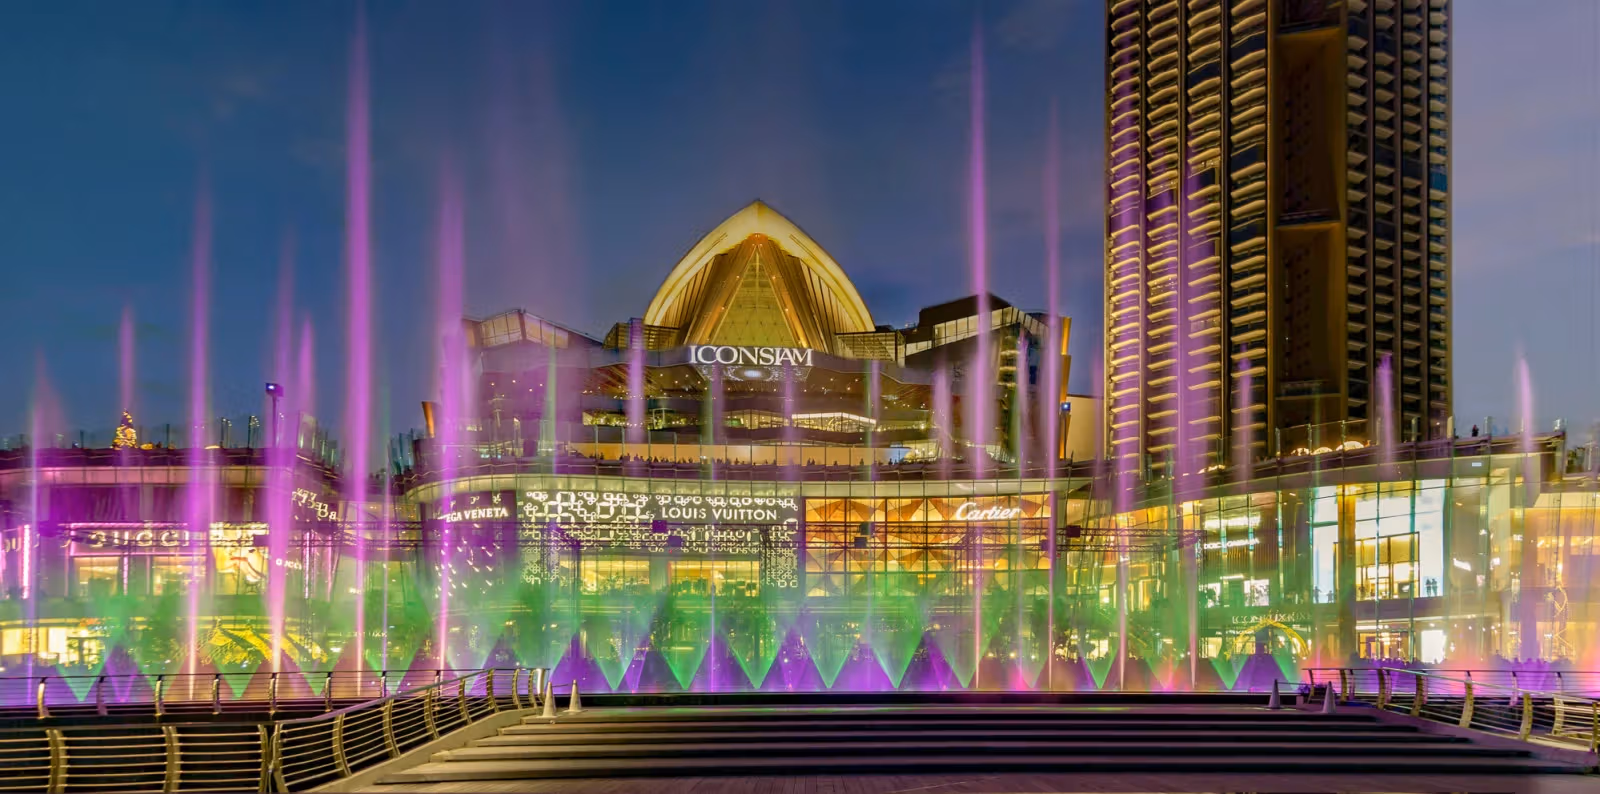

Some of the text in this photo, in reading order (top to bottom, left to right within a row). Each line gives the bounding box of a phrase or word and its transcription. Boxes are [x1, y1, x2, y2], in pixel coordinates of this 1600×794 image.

[689, 345, 813, 366] ICONSIAM
[464, 506, 509, 520] VENETA
[661, 507, 777, 520] LOUIS VUITTON
[956, 502, 1021, 521] Cartier
